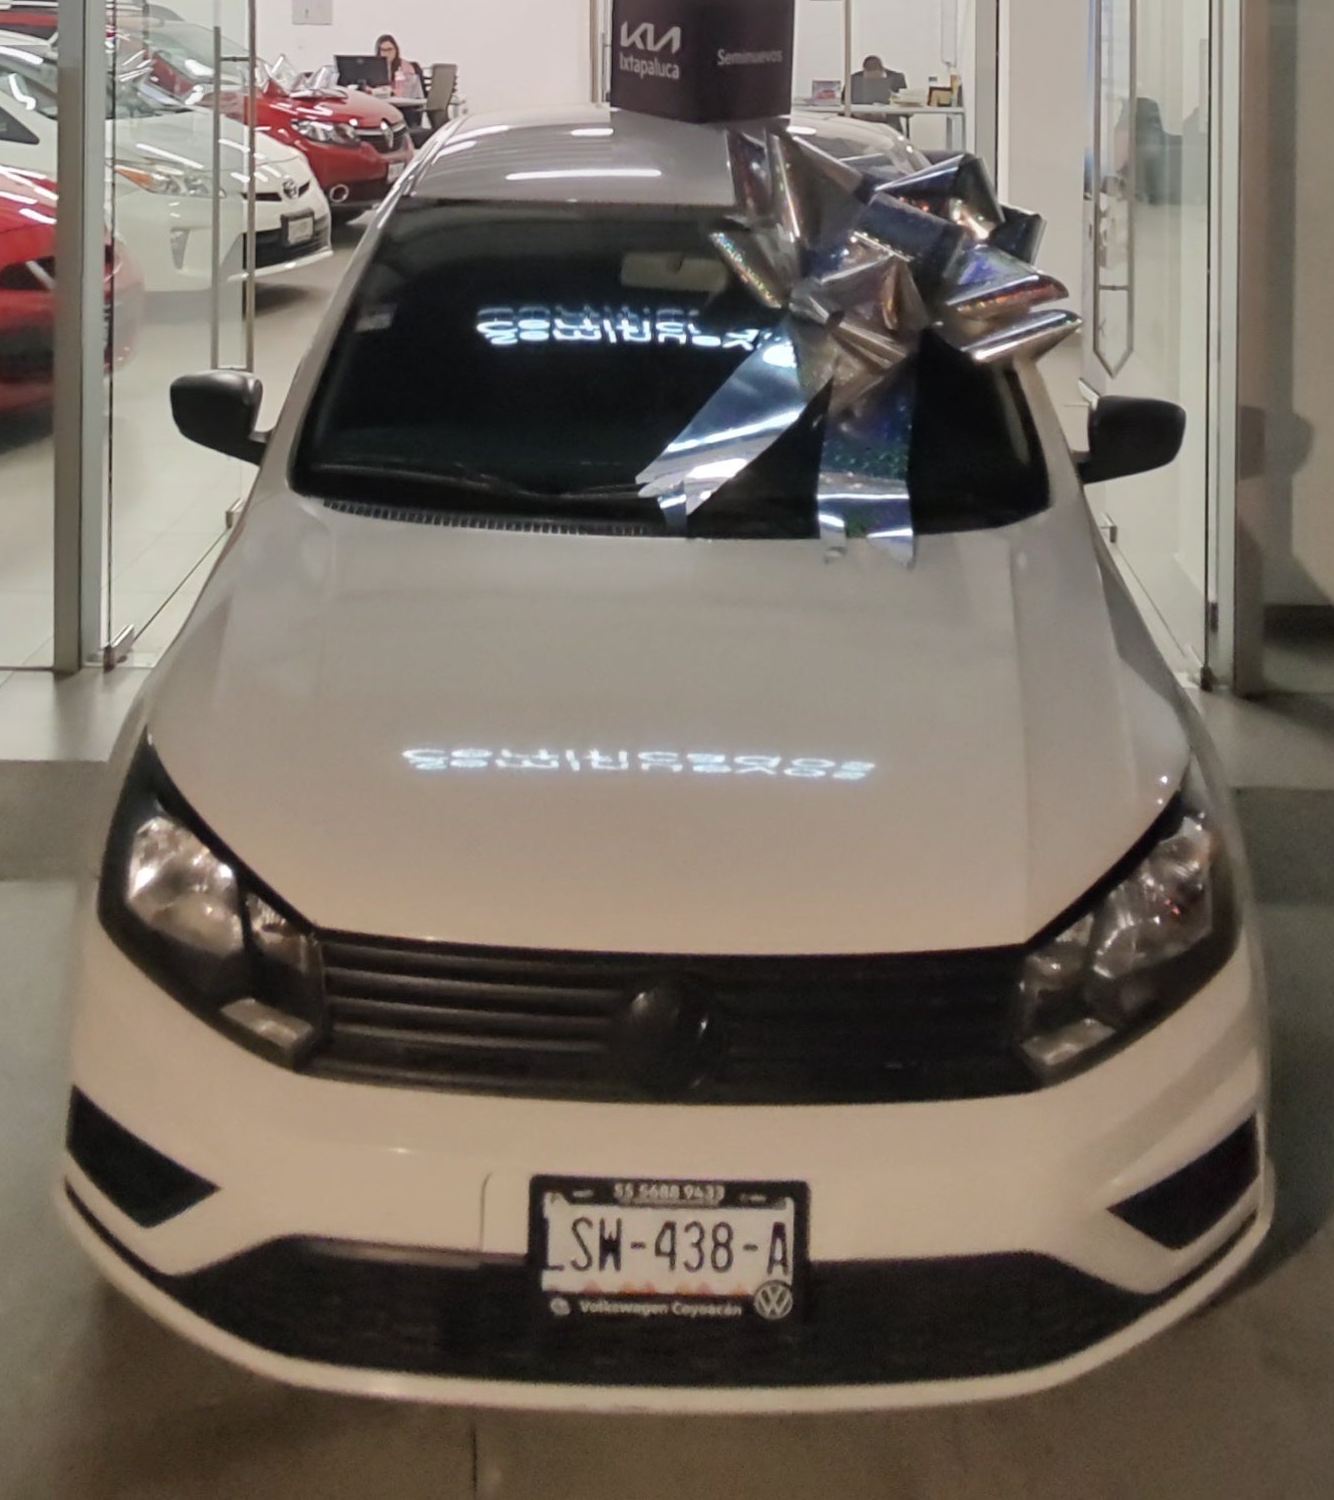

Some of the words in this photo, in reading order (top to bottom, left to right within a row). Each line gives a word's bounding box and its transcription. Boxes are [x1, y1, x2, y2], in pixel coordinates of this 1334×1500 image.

[619, 53, 680, 80] Ixtapaluca
[717, 49, 783, 67] Seminuevos
[579, 1299, 668, 1316] Volkswagen
